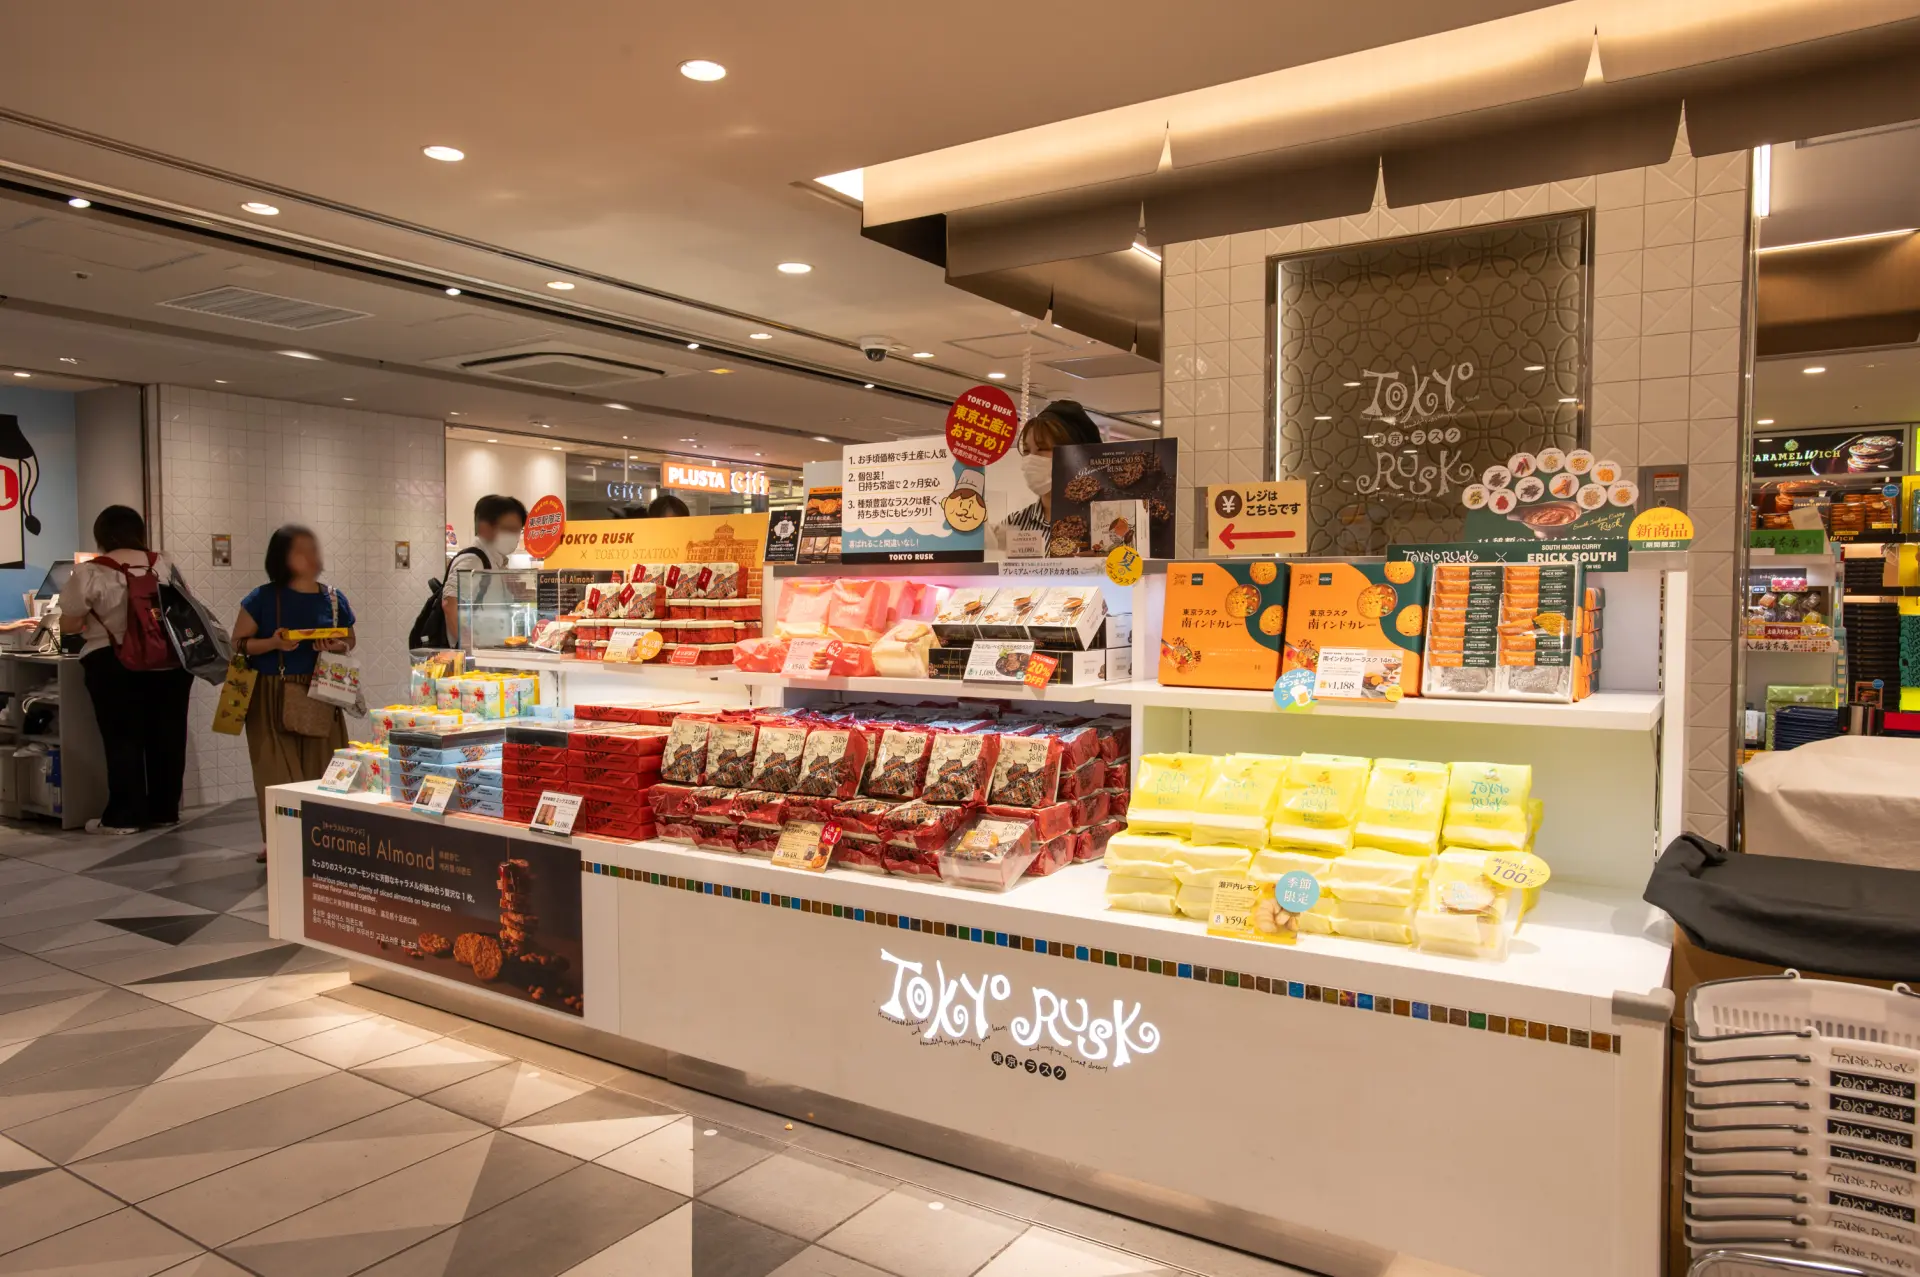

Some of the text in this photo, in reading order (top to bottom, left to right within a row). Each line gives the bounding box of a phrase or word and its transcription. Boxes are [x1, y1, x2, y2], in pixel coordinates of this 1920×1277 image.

[1362, 362, 1473, 423] TOKYO
[968, 395, 1012, 416] TOKYO RUSK
[954, 404, 1013, 437] 東京土産に
[1372, 428, 1461, 447] 東京・ラスク
[858, 449, 947, 464] お手頃価格で手土産に人気
[1752, 450, 1840, 462] ARAMELWICH
[669, 467, 725, 488] PLUSTA
[1357, 450, 1474, 497] RUSK
[1246, 490, 1278, 502] レジは
[1246, 503, 1300, 516] こちらです
[527, 525, 560, 539] パッケージ
[1636, 523, 1688, 537] 新商品
[560, 533, 634, 545] TOKYO RUSK
[596, 548, 679, 559] TOKYO STATION
[1528, 553, 1567, 563] ERICK
[1572, 552, 1616, 562] SOUTH
[540, 575, 595, 583] Caramel Almond
[1182, 618, 1243, 628] 南インドカレー
[1308, 619, 1376, 630] 南インドカレー
[1029, 661, 1050, 676] 20%
[1024, 674, 1044, 686] OFF!
[1279, 676, 1314, 688] おつまみに
[1283, 671, 1310, 681] ビールの
[1328, 681, 1354, 690] ¥1,188
[1470, 781, 1510, 795] TOKYO
[311, 826, 434, 871] Caramel Almond
[313, 882, 329, 890] caramel
[343, 889, 356, 897] mixed
[316, 874, 335, 884] luxurious
[359, 885, 372, 894] plenty
[380, 890, 393, 898] sliced
[394, 893, 413, 904] almonds
[1287, 877, 1311, 890] 季節
[1283, 890, 1308, 905] 限定
[880, 949, 1160, 1067] TOKYO RUSK
[991, 1051, 1066, 1080] 東京・ラスク
